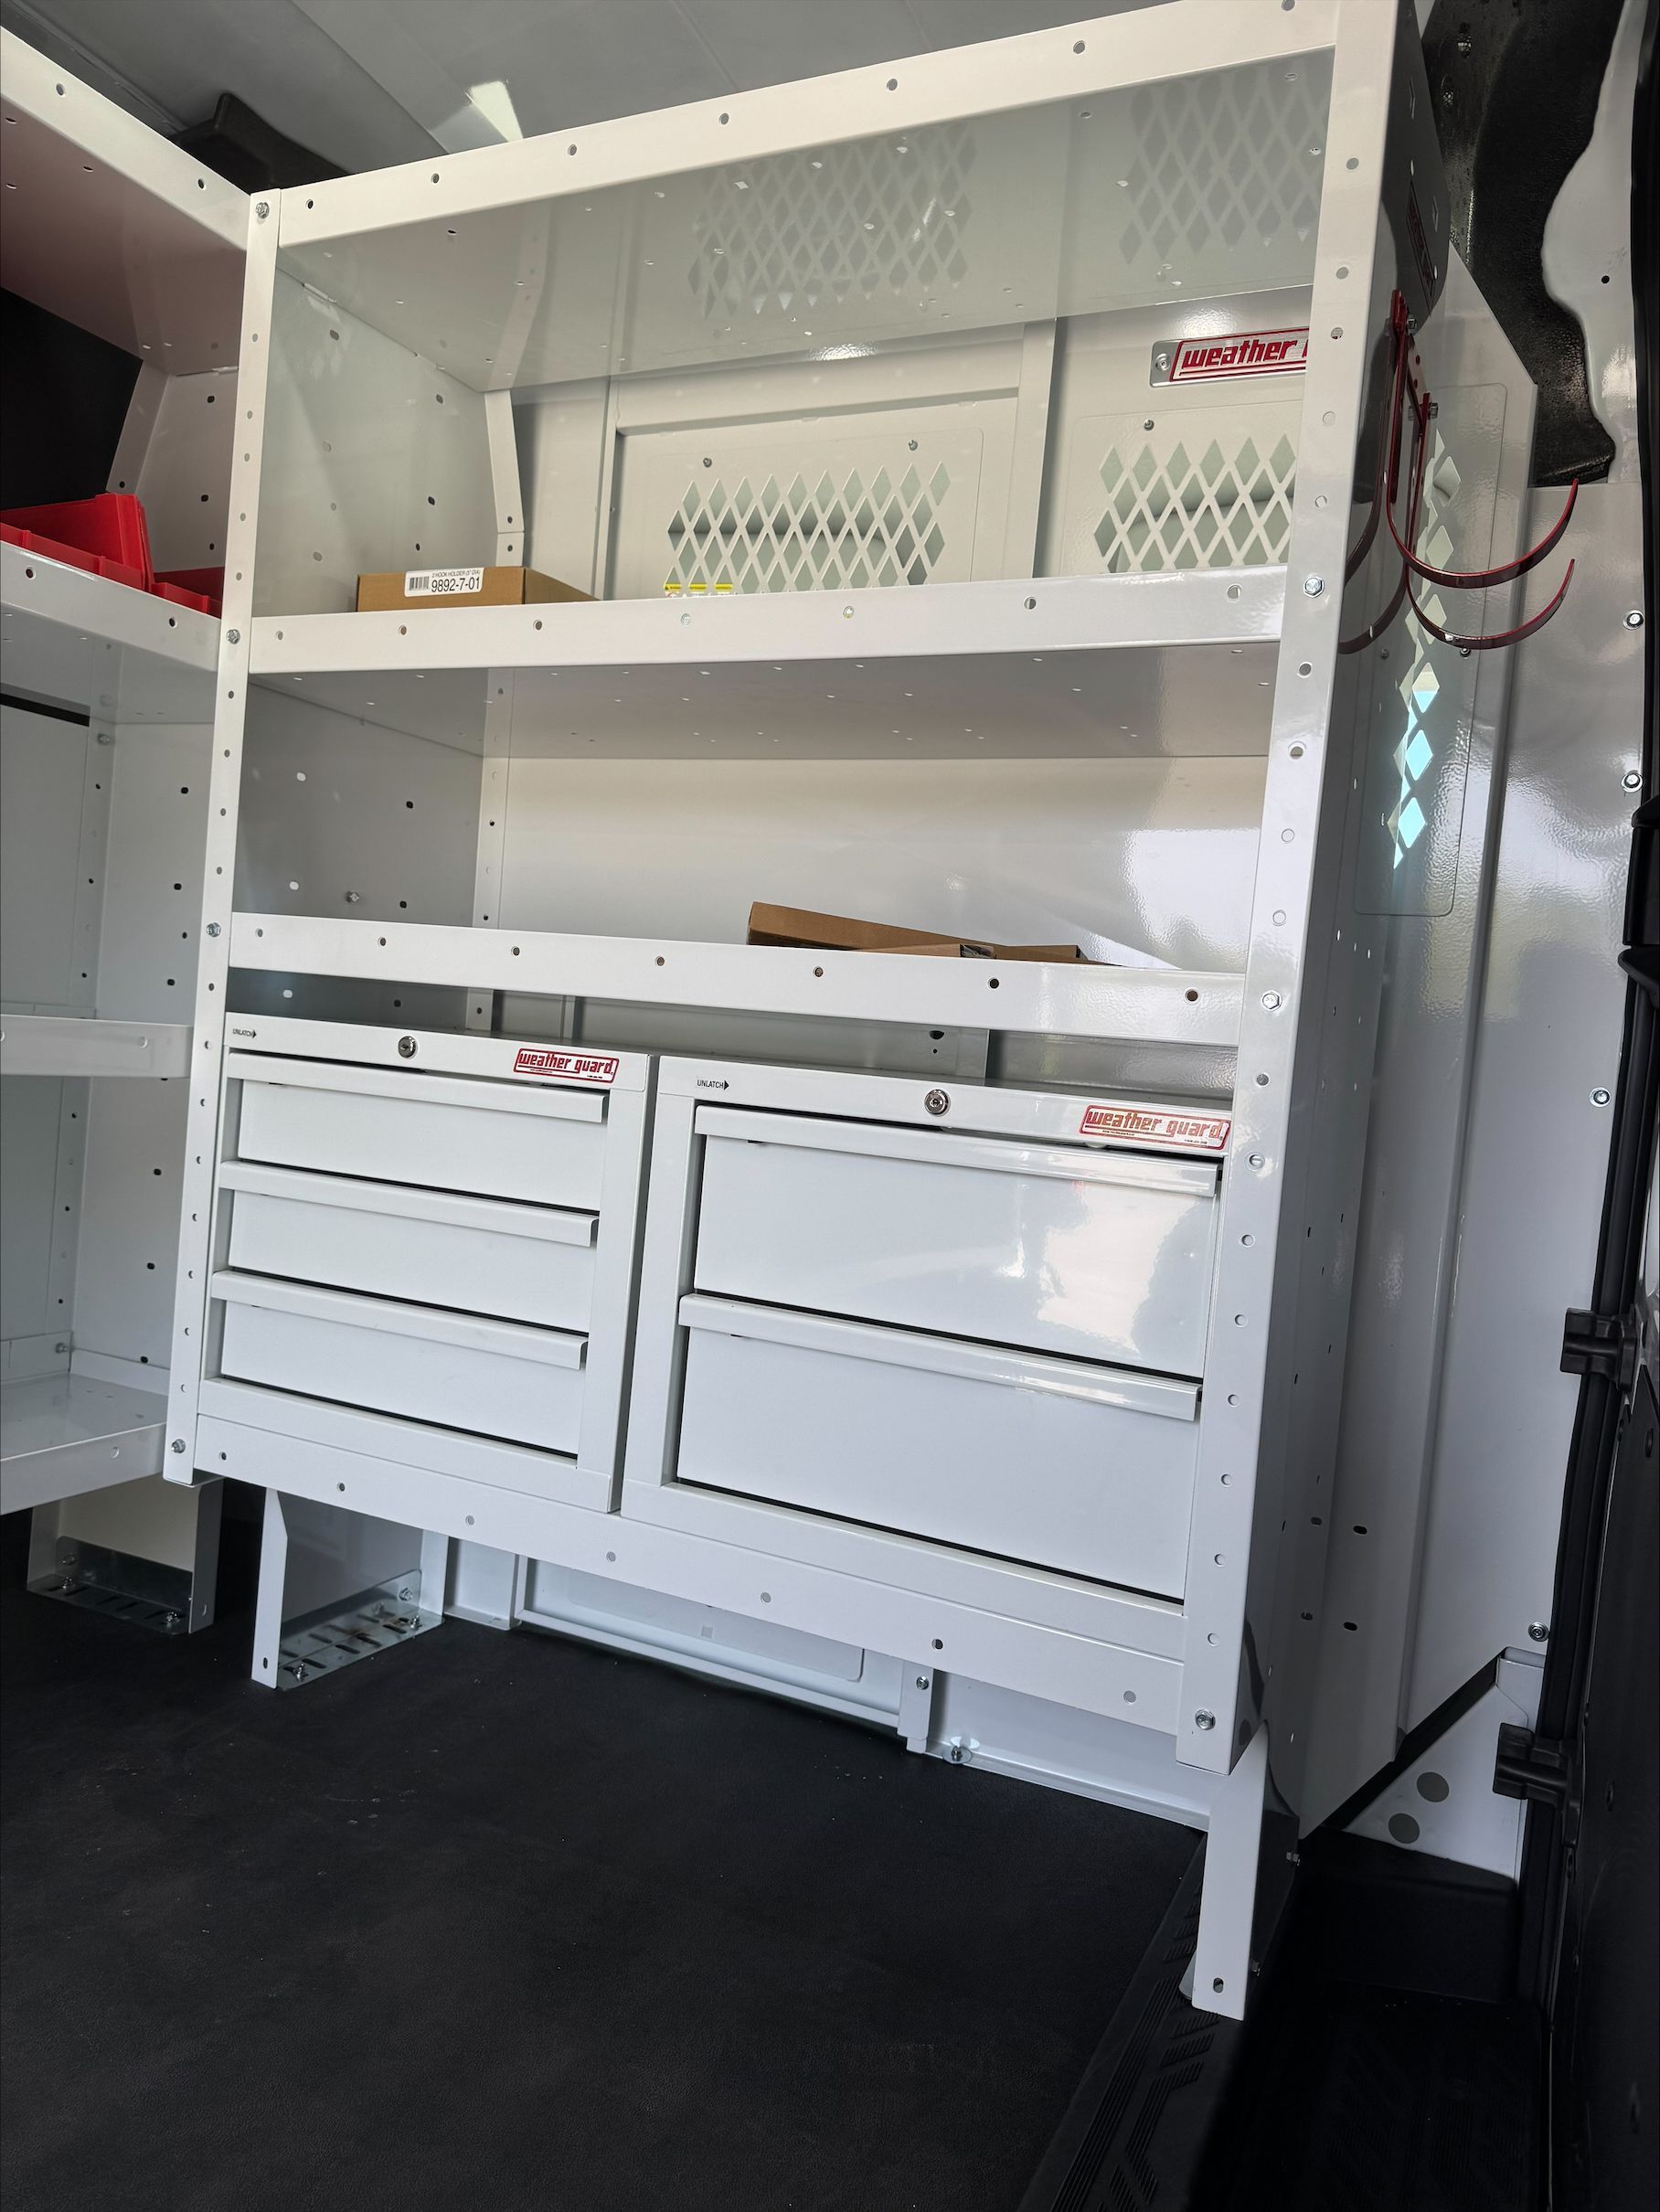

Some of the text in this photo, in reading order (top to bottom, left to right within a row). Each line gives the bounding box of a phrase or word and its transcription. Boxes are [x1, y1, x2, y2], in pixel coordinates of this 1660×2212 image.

[1182, 339, 1297, 369] weather
[431, 577, 480, 592] 9892-7-01
[517, 1052, 613, 1074] weather guard
[697, 1079, 724, 1089] UNLATCH
[1085, 1111, 1223, 1139] weather guard
